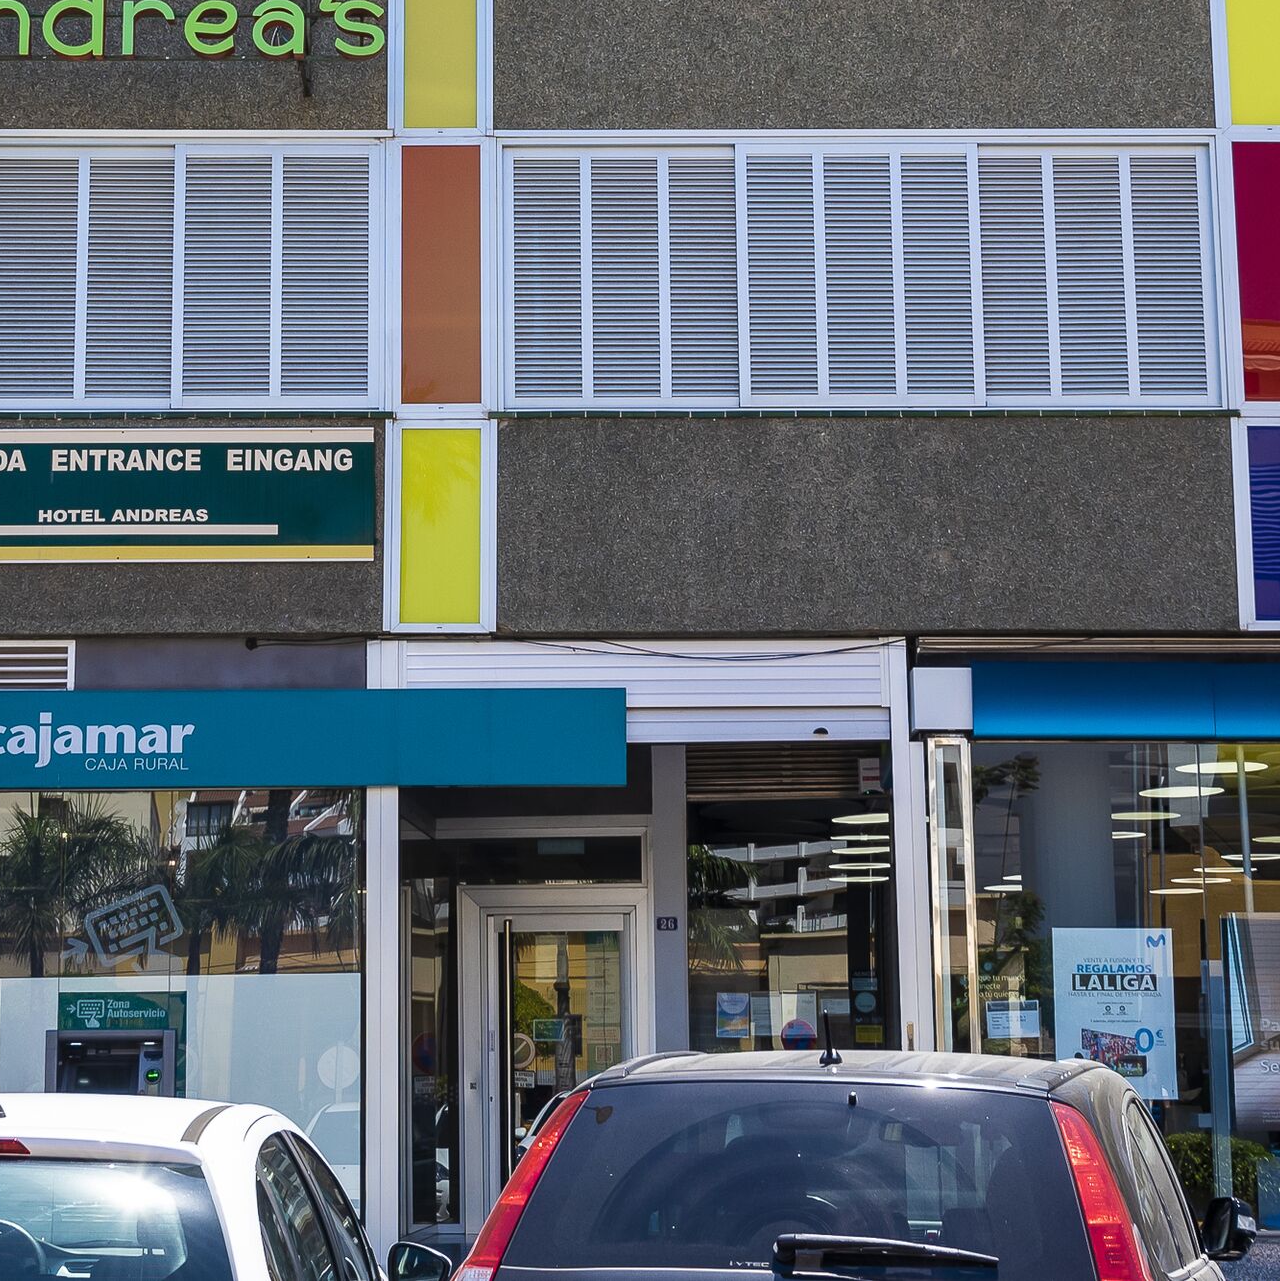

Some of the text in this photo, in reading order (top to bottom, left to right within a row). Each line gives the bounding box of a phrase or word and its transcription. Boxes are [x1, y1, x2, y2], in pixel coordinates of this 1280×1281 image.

[51, 449, 202, 472] ENTRANCE
[226, 449, 353, 472] EINGANG
[38, 509, 209, 523] HOTEL ANDREAS
[84, 757, 189, 771] CAJA RURAL
[660, 919, 675, 929] 26
[1076, 964, 1152, 973] REGALAMOS
[1074, 974, 1155, 991] LALIGA
[107, 999, 130, 1008] Zona
[107, 1008, 166, 1018] Autoservicio
